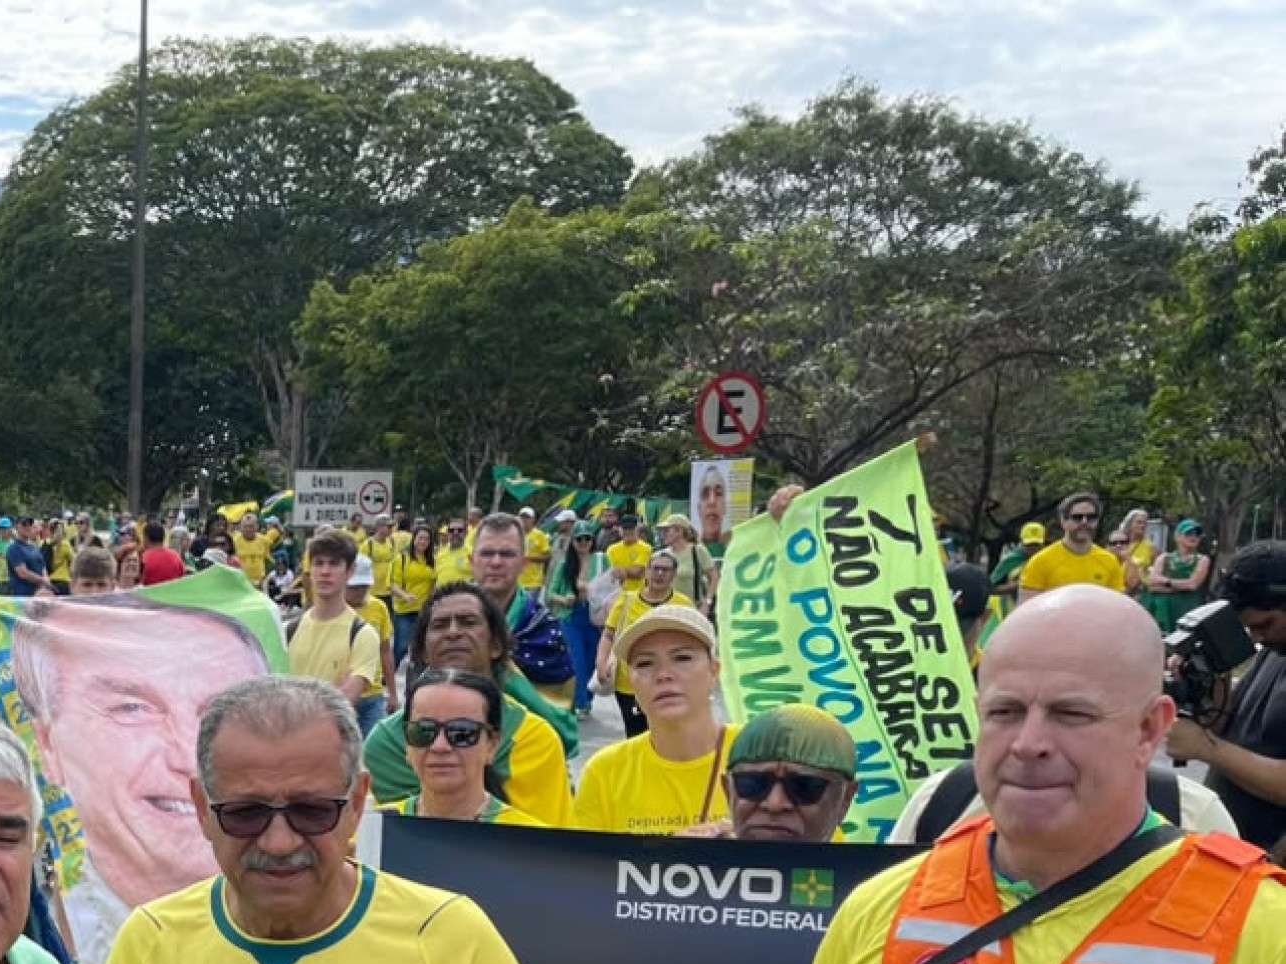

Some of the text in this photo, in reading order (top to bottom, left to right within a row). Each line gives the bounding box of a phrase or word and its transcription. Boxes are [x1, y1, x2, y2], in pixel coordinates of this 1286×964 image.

[717, 390, 745, 434] E
[786, 527, 819, 566] O
[823, 496, 880, 588] NÃO
[731, 552, 783, 660] SEM
[894, 587, 947, 653] DE
[789, 588, 864, 724] POVO
[915, 674, 976, 760] SET
[616, 859, 783, 903] NOVO
[616, 900, 829, 931] DISTRITO FEDERAL
